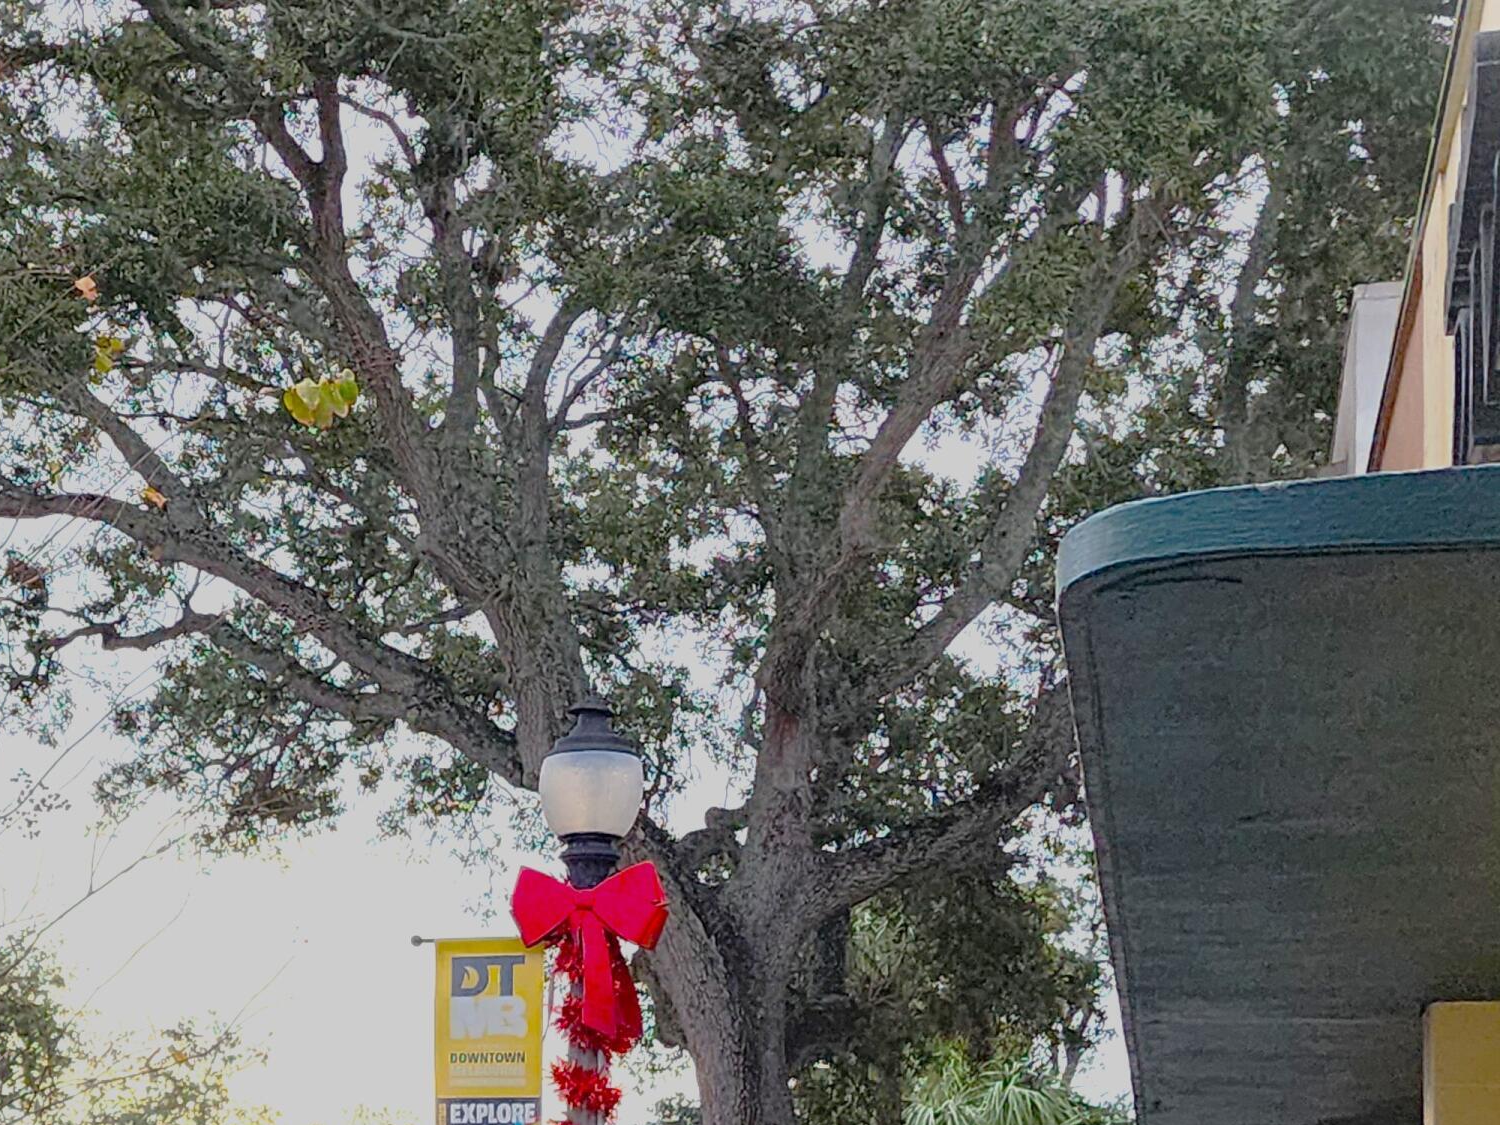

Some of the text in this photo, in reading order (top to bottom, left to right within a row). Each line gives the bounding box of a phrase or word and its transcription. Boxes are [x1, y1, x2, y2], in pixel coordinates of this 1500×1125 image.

[451, 954, 526, 997] DT
[450, 1052, 526, 1064] DOWNTOWN
[449, 1102, 536, 1125] EXPLORE
